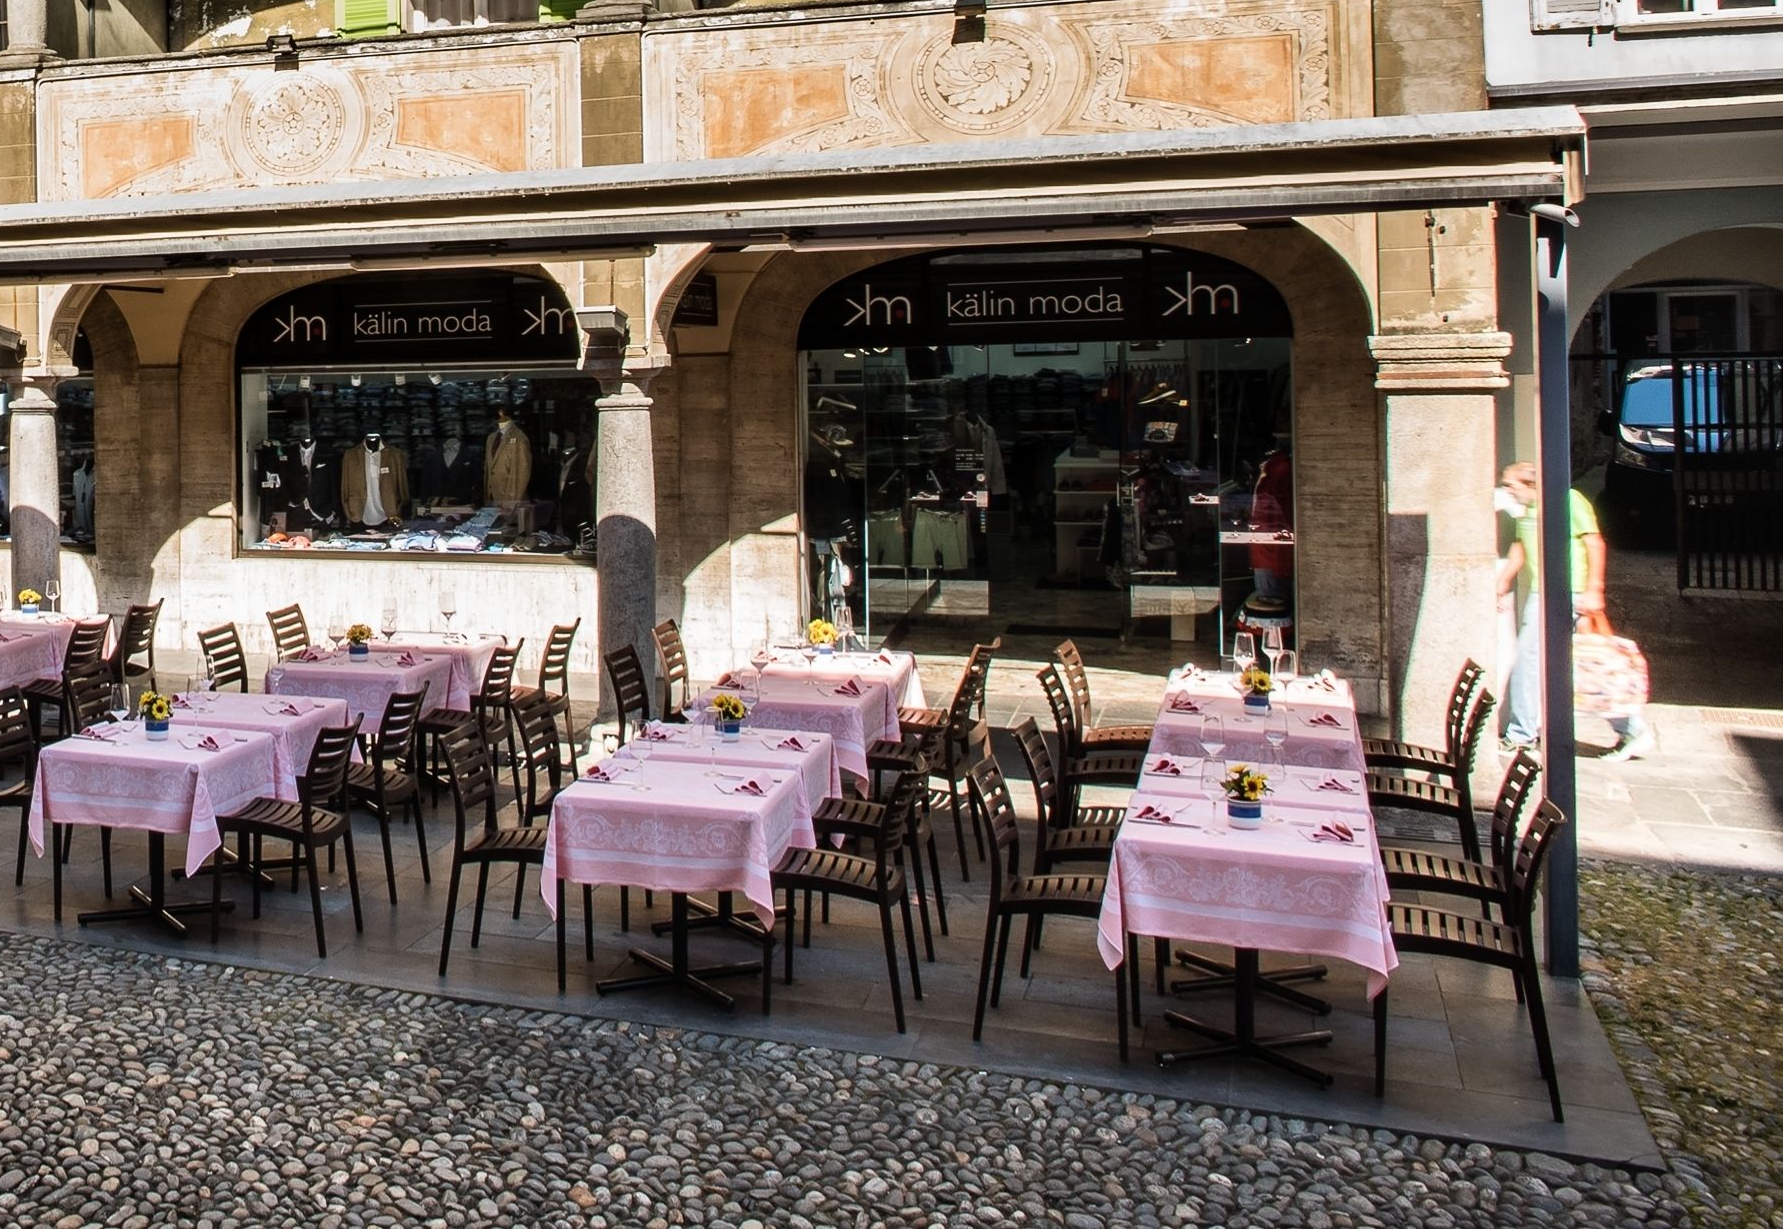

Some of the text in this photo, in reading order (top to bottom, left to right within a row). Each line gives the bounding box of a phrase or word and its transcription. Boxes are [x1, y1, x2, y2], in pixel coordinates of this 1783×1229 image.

[947, 286, 1124, 318] kälin moda
[354, 308, 492, 335] kälin moda
